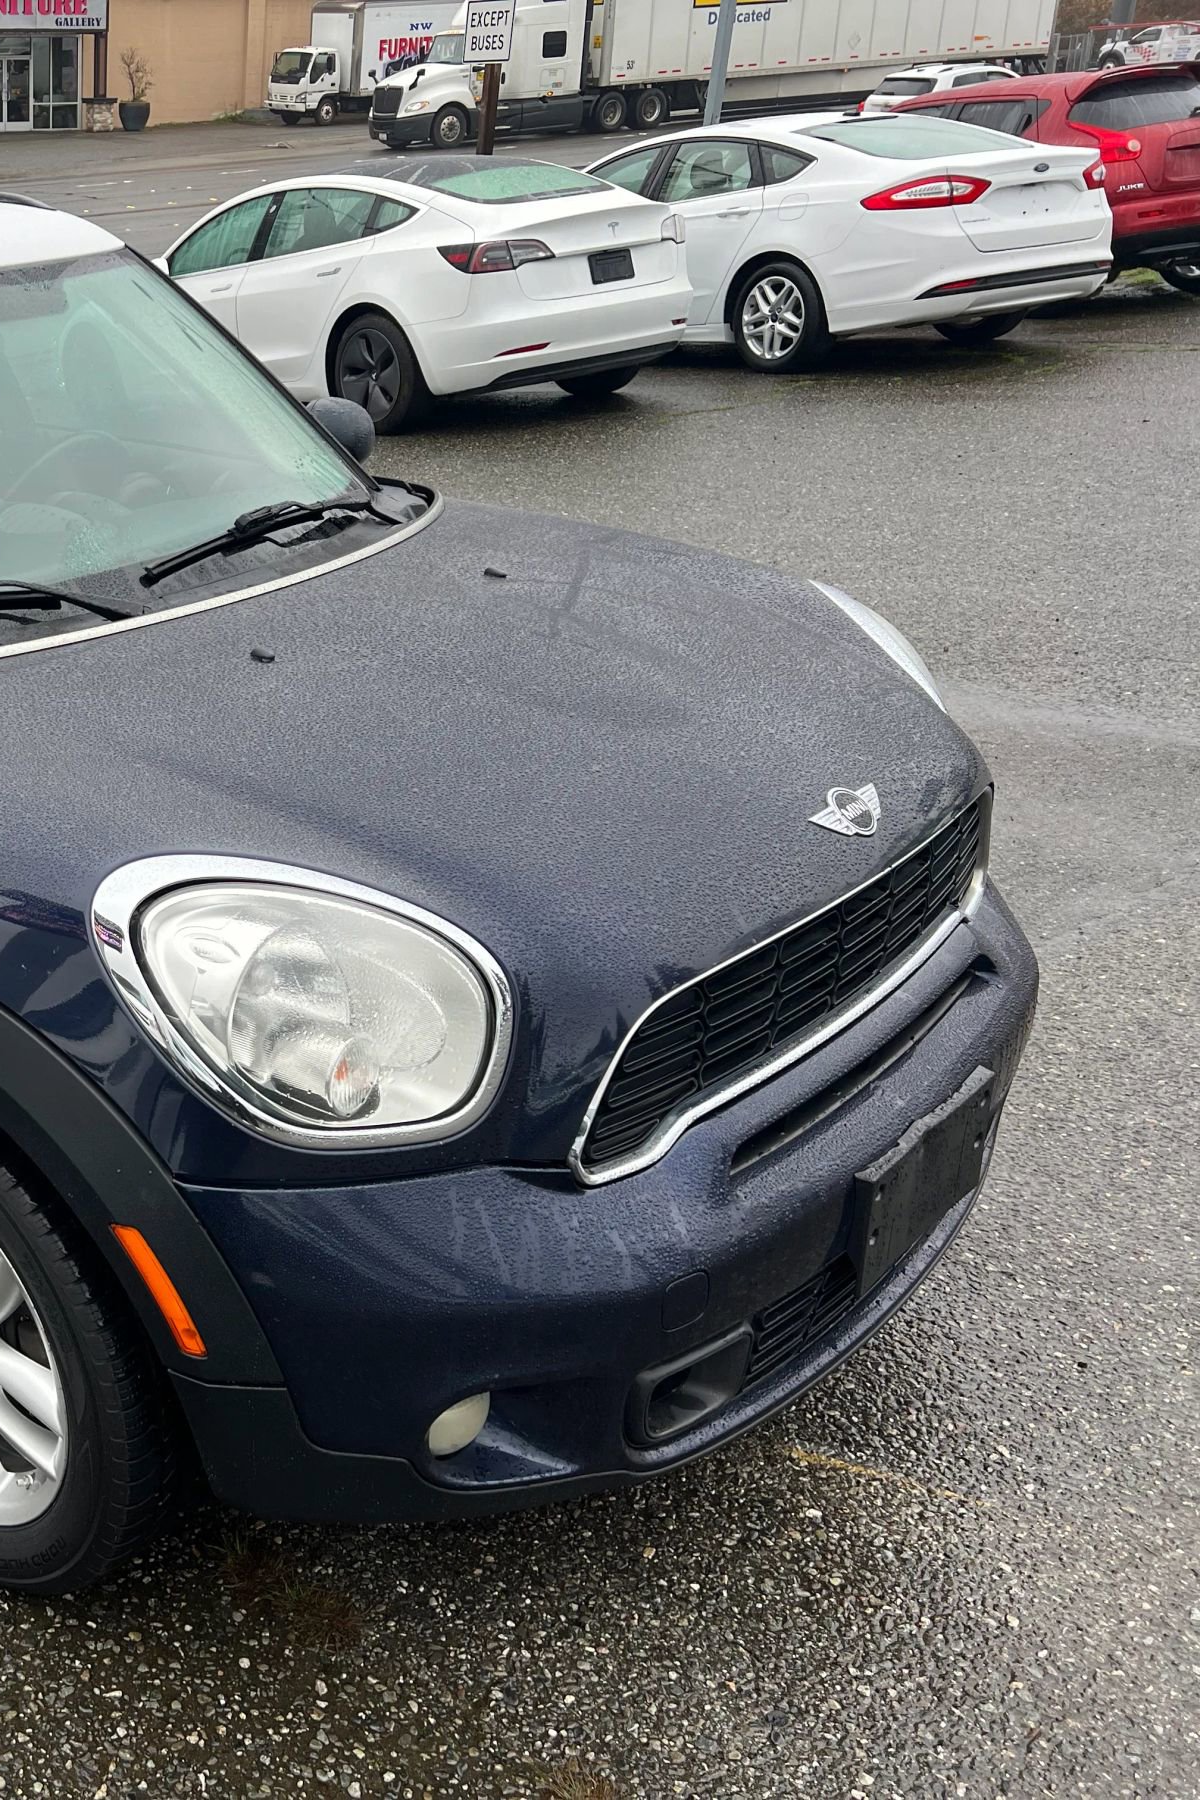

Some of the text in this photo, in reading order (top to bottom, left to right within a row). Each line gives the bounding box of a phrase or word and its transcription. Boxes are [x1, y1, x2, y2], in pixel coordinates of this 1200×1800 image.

[55, 17, 102, 27] GALLERY
[470, 10, 510, 28] EXCEPT
[708, 8, 771, 25] Dcated
[409, 23, 433, 31] NW
[470, 34, 504, 51] BUSES
[1116, 183, 1145, 192] JUKE
[841, 799, 868, 820] MINI
